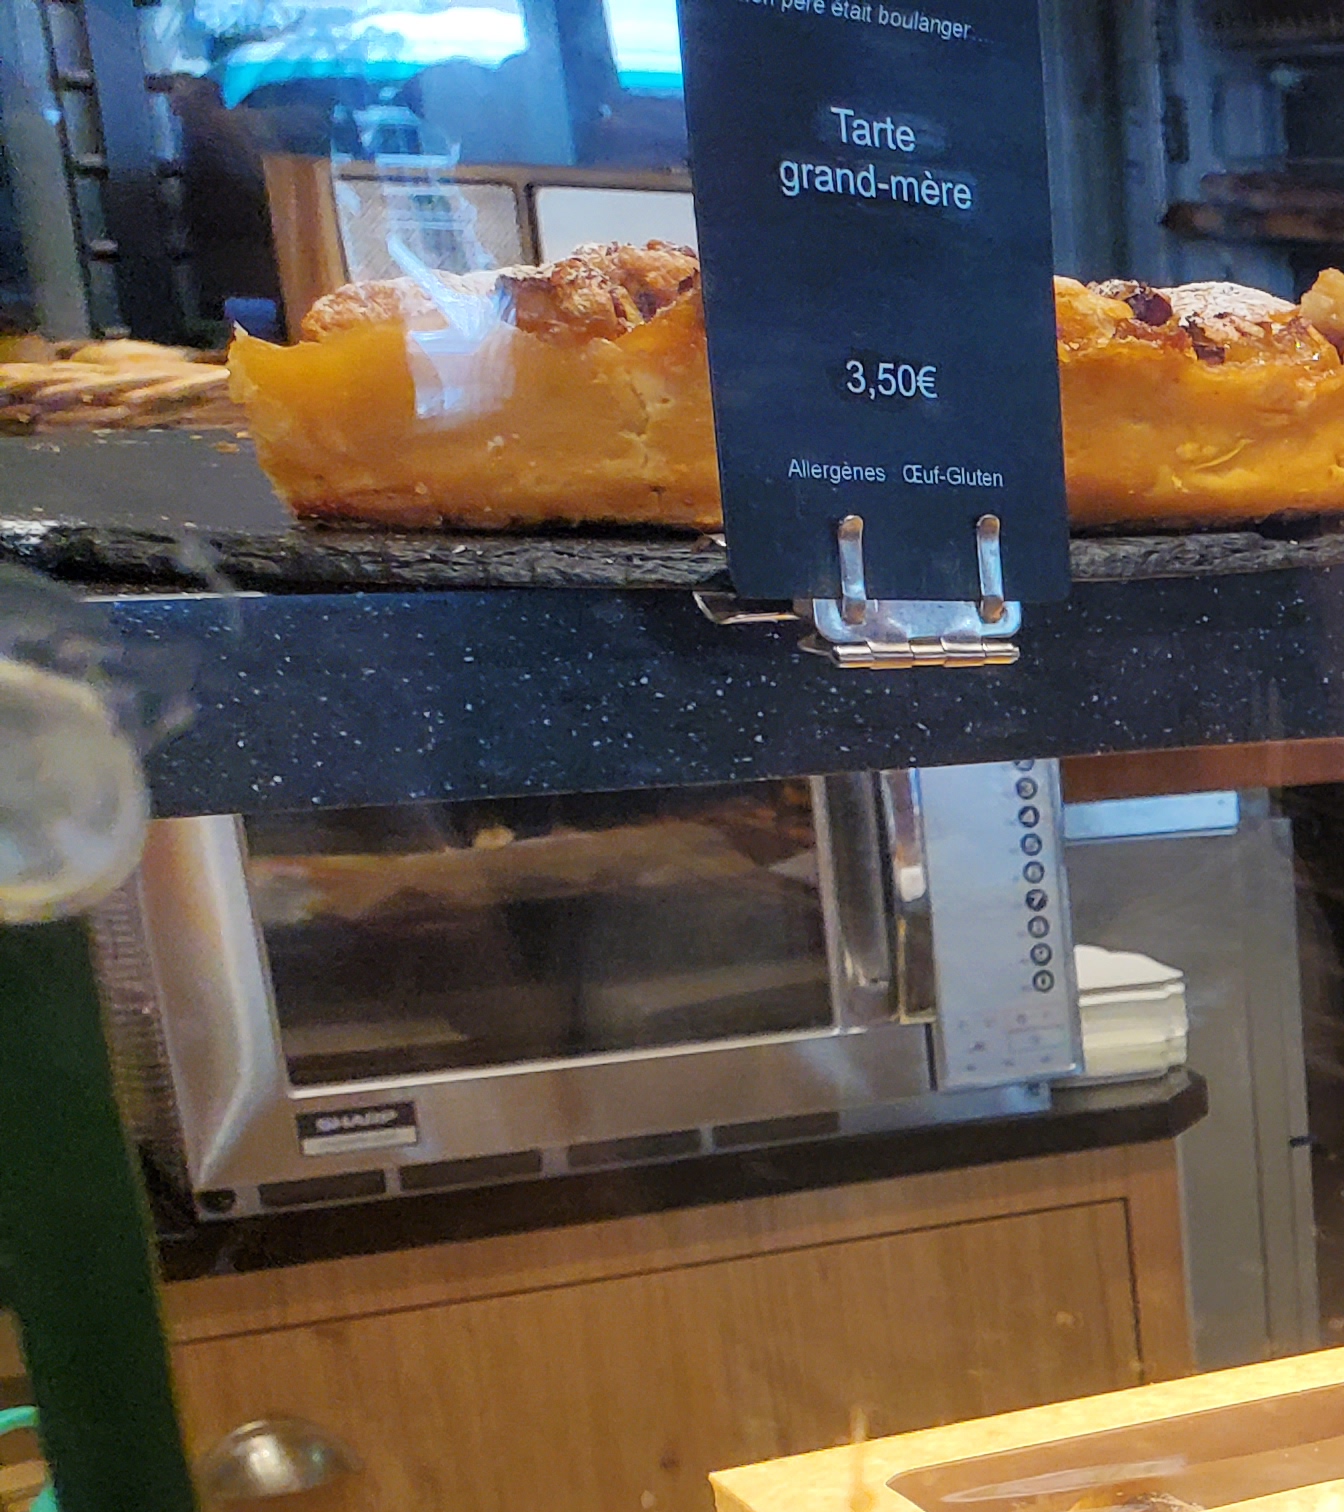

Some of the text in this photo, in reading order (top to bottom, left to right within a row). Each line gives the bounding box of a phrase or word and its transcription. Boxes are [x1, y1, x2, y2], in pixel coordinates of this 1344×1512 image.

[830, 106, 916, 152] Tarte
[779, 159, 972, 210] grand-mère
[844, 359, 938, 400] 3,50€
[788, 458, 1004, 488] Allergènes Œuf-Gluten
